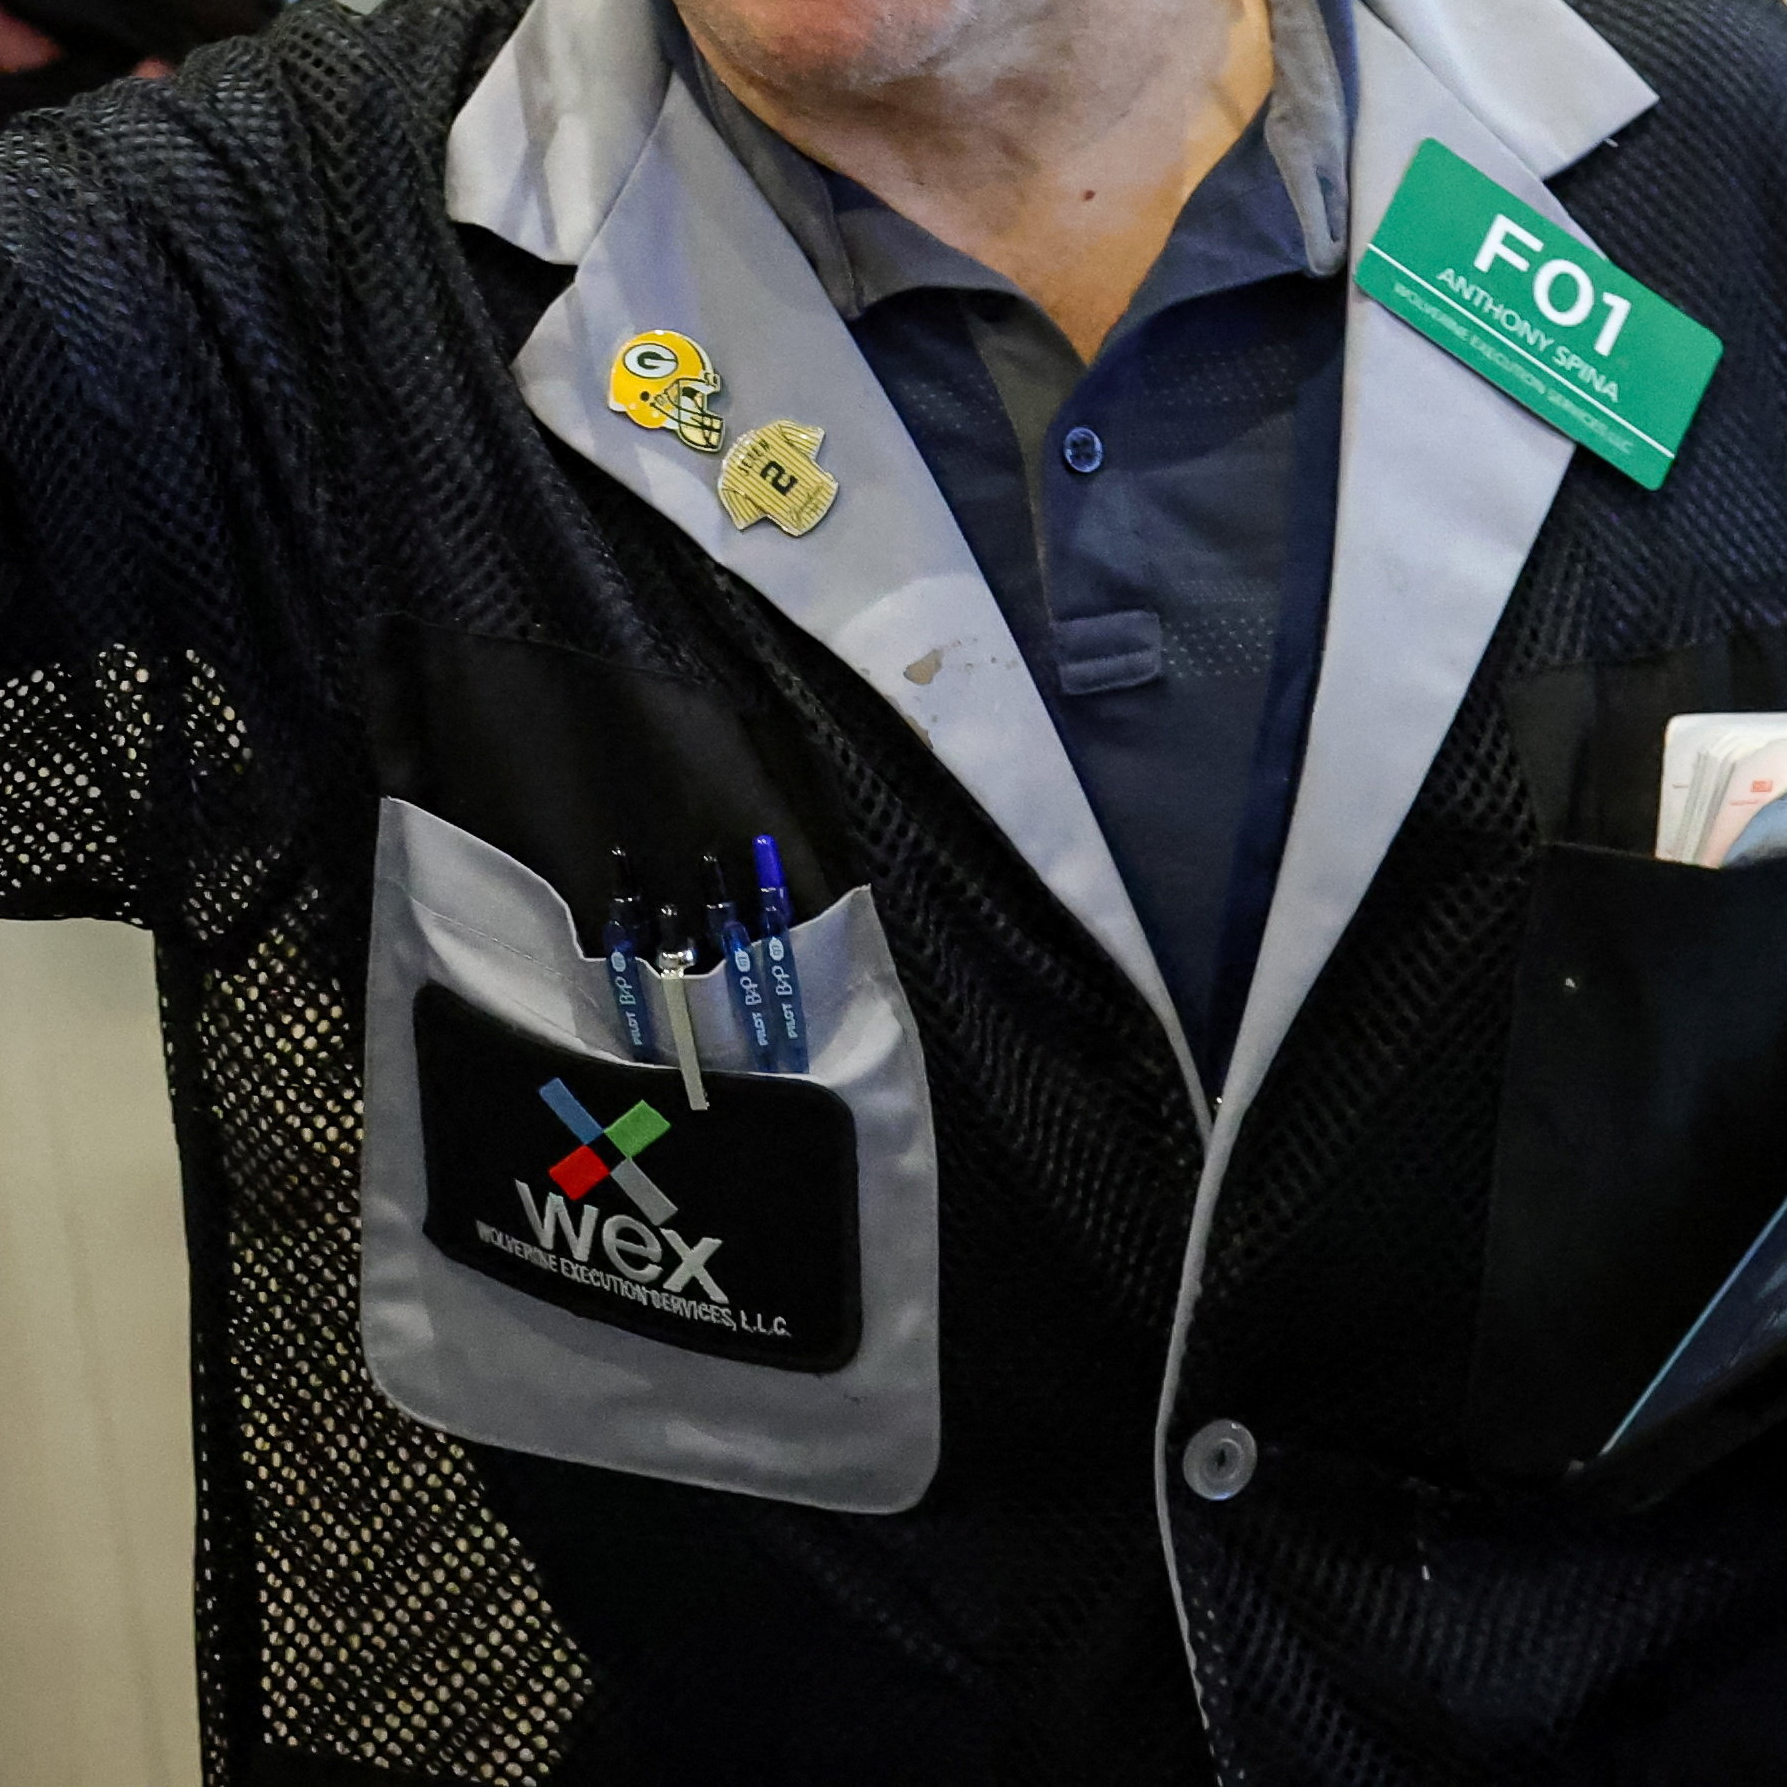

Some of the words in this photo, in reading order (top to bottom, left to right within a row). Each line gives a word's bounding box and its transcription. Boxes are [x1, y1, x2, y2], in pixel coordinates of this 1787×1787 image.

[1435, 267, 1555, 353] ANTHONY
[1552, 345, 1619, 404] SPINA
[759, 460, 799, 497] 2
[625, 1010, 644, 1047] PILOT
[751, 1011, 770, 1047] PILOT
[781, 1002, 799, 1039] PILOT
[515, 1178, 731, 1305] wex
[559, 1256, 649, 1307] EXECUTION
